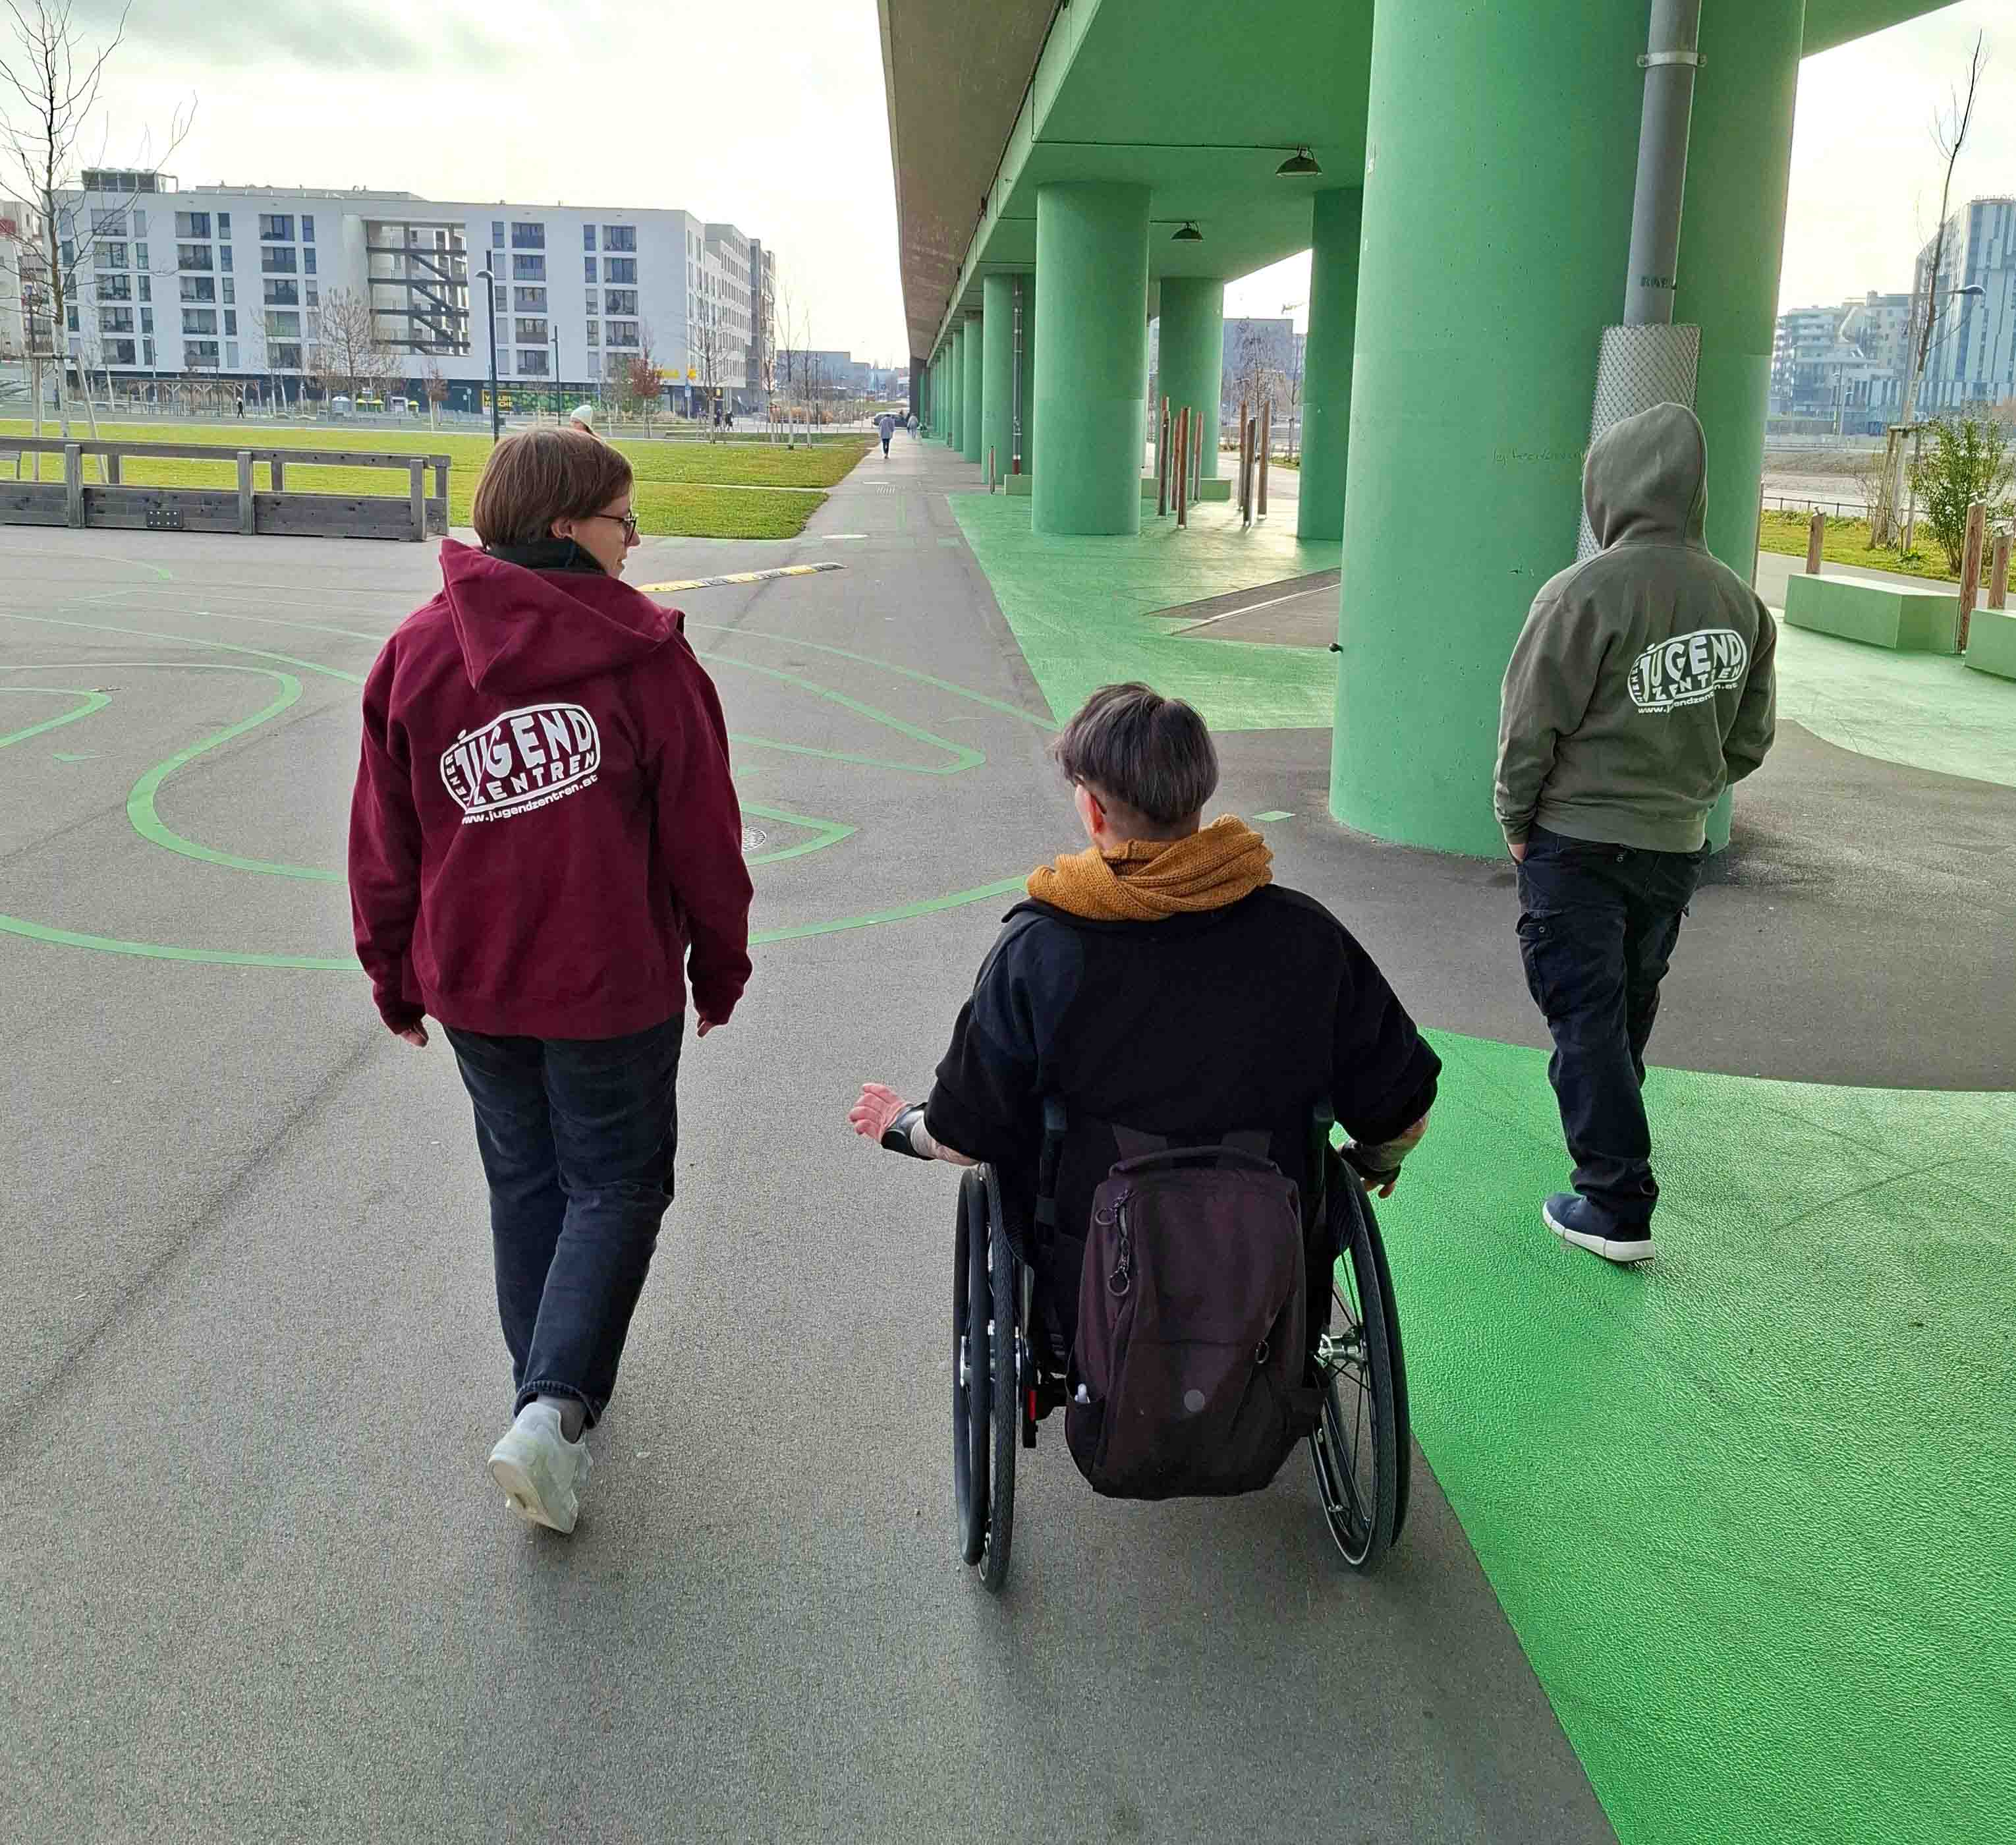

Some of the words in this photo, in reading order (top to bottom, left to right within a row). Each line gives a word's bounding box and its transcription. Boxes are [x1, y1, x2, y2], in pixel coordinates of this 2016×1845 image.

[1640, 635, 1741, 702] JUGEND
[1652, 665, 1741, 700] ZENTEN
[454, 710, 592, 791] JUGEND
[445, 754, 470, 802] IENER
[473, 751, 594, 805] ZENTREN
